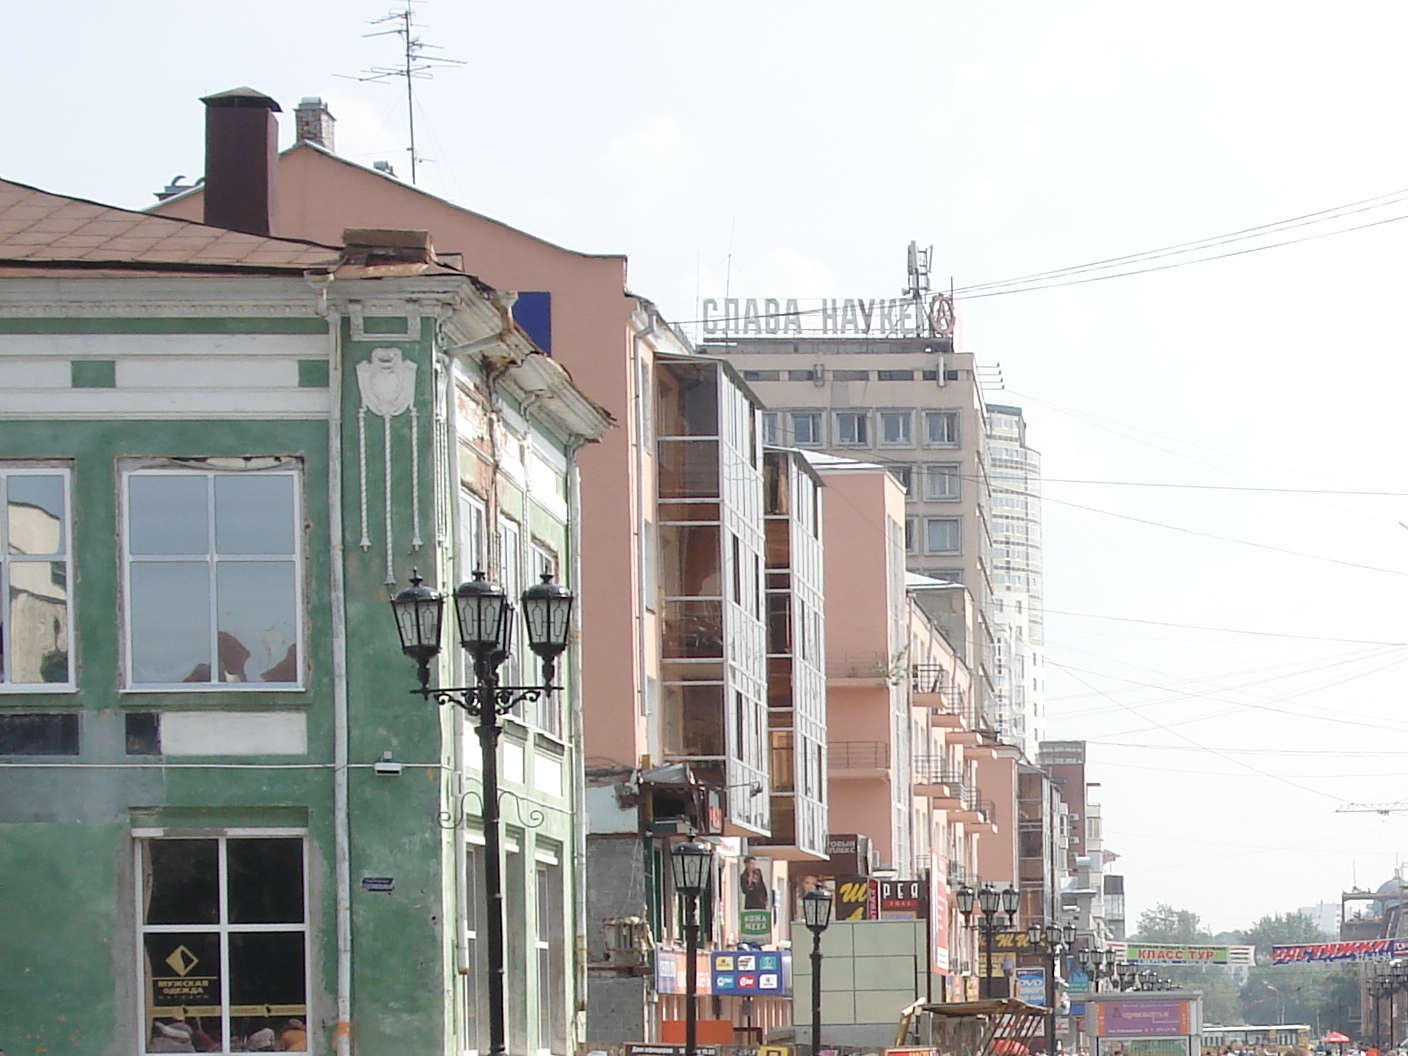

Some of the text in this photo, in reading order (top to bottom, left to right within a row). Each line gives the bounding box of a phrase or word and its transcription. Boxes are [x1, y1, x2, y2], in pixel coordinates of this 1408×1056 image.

[703, 297, 914, 335] СЛАВА НАУКЕ
[1138, 950, 1214, 960] КЛАСС ТУР
[158, 980, 209, 988] МУЖСКАЯ
[163, 987, 203, 995] ОДЕЖДА
